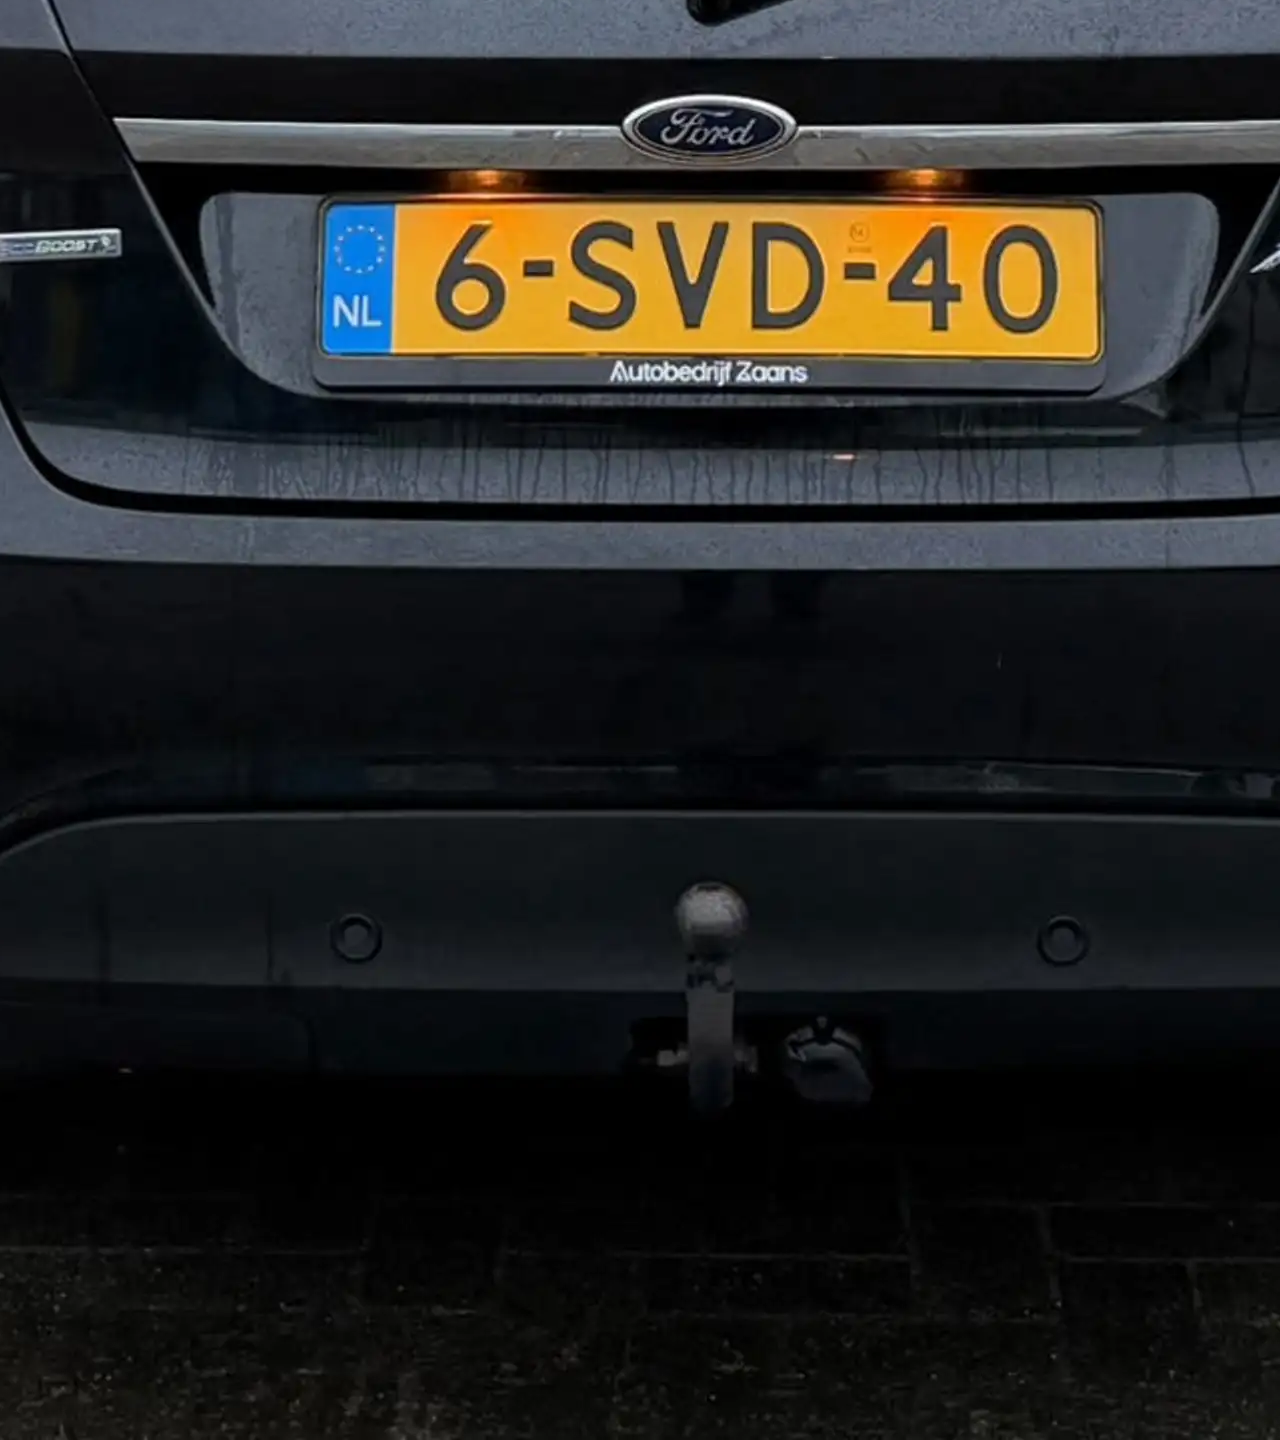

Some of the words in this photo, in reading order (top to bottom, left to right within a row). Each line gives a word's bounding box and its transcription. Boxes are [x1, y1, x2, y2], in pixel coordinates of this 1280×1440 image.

[659, 108, 757, 146] Ford
[435, 220, 1059, 333] 6-SVD-40
[333, 294, 383, 328] NL
[610, 360, 733, 387] Autobedrijf
[735, 361, 808, 383] Zaans
